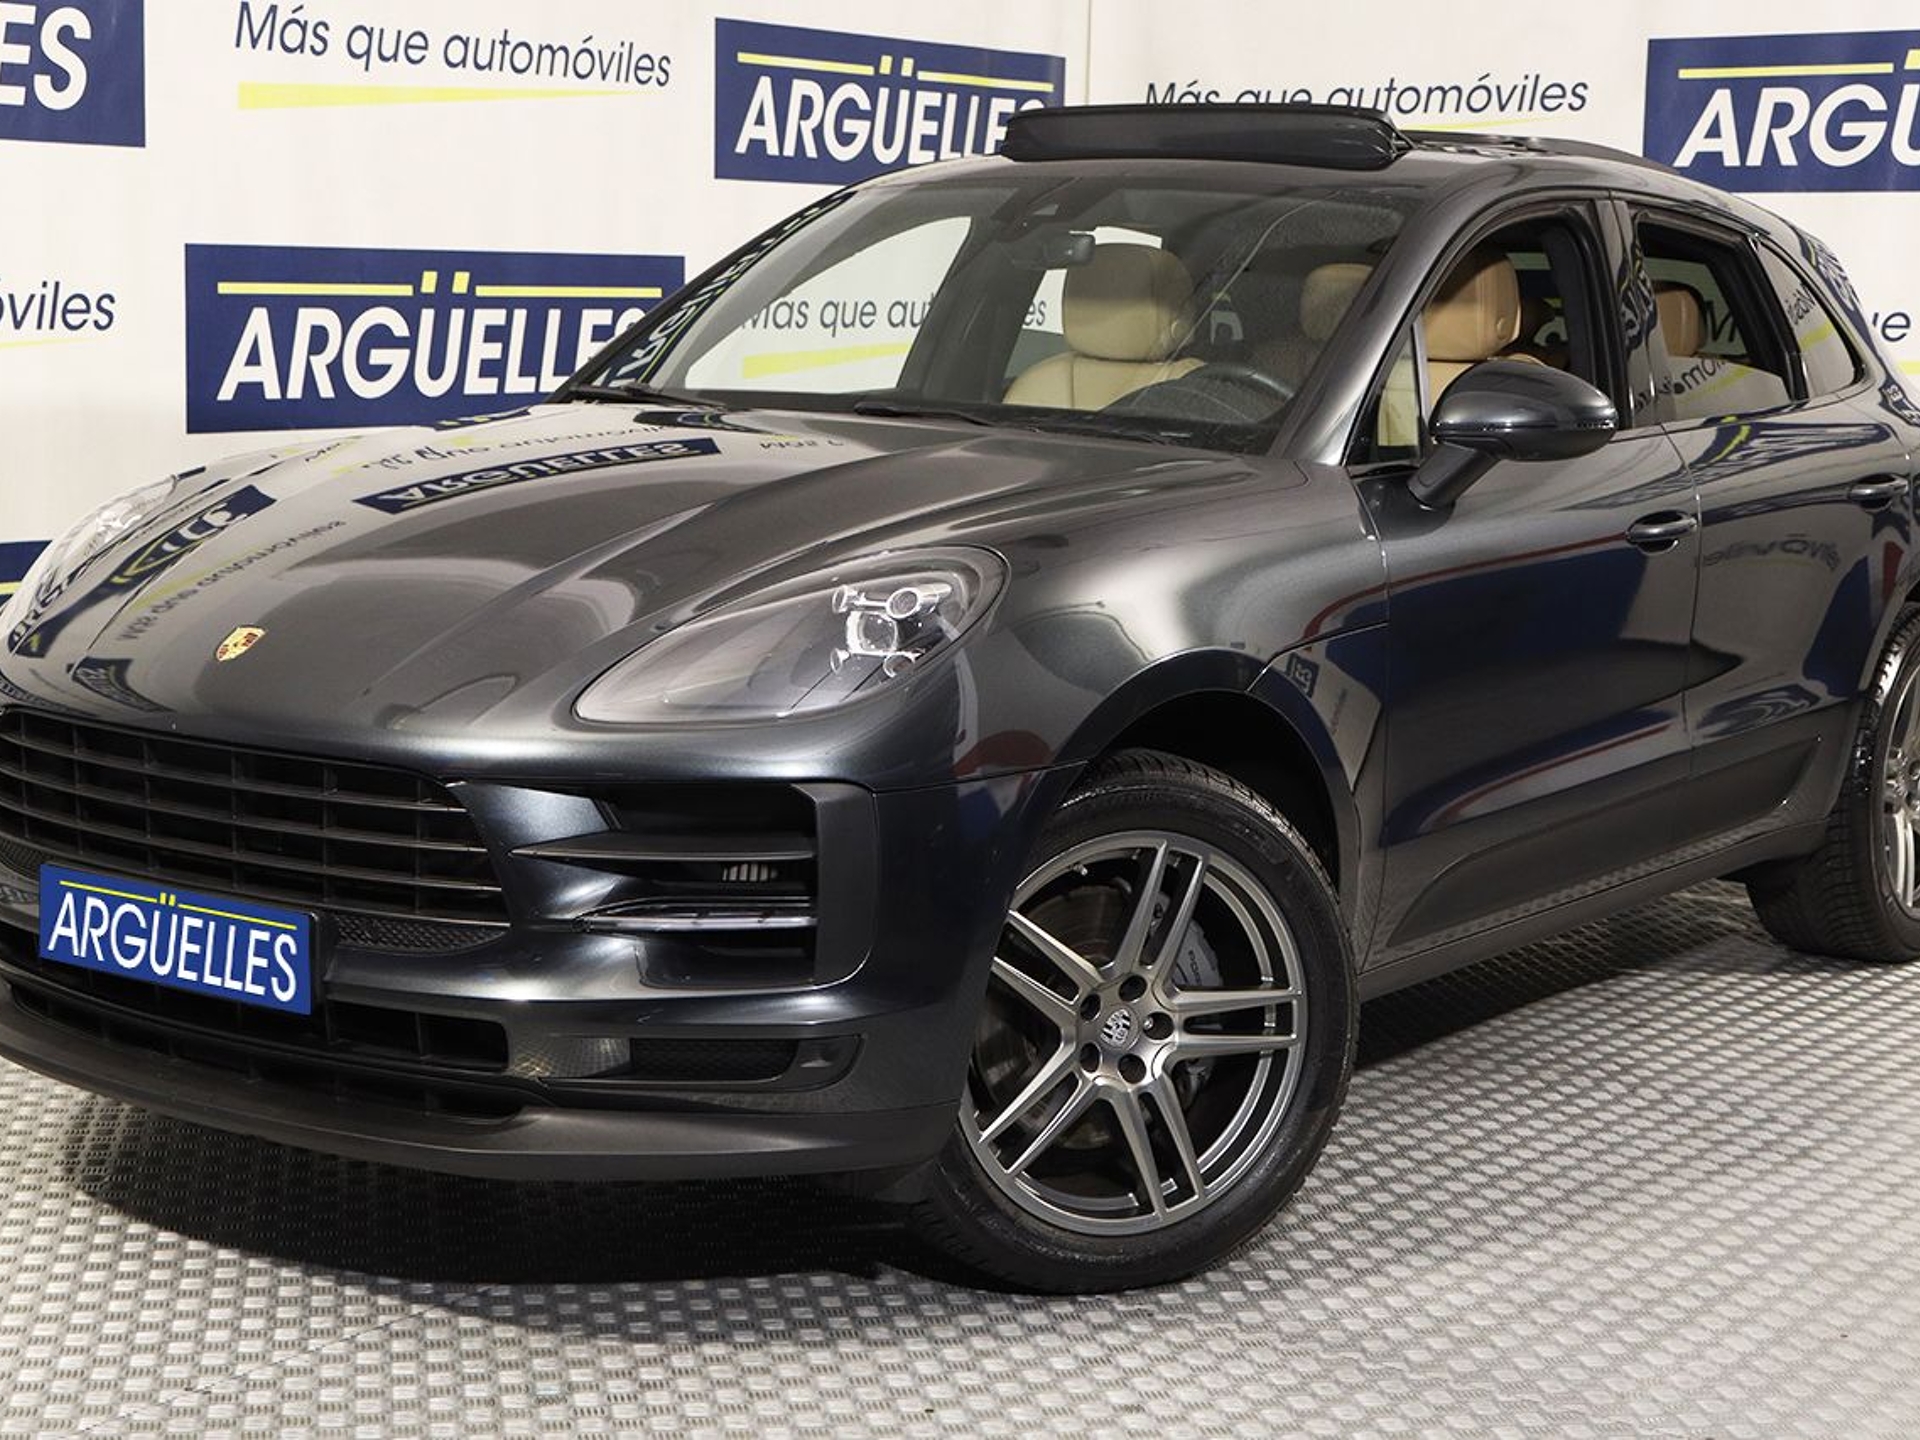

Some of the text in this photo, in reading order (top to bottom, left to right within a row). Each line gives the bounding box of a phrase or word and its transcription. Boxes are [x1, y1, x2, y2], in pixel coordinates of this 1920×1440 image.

[235, 1, 671, 87] Más que automóviles
[734, 54, 1046, 164] ARGÜELLE
[1328, 73, 1589, 114] automóviles
[0, 280, 116, 331] viles
[216, 271, 647, 400] ARGÜELLE
[819, 301, 878, 337] que
[48, 892, 298, 1002] ARGÜELLES
